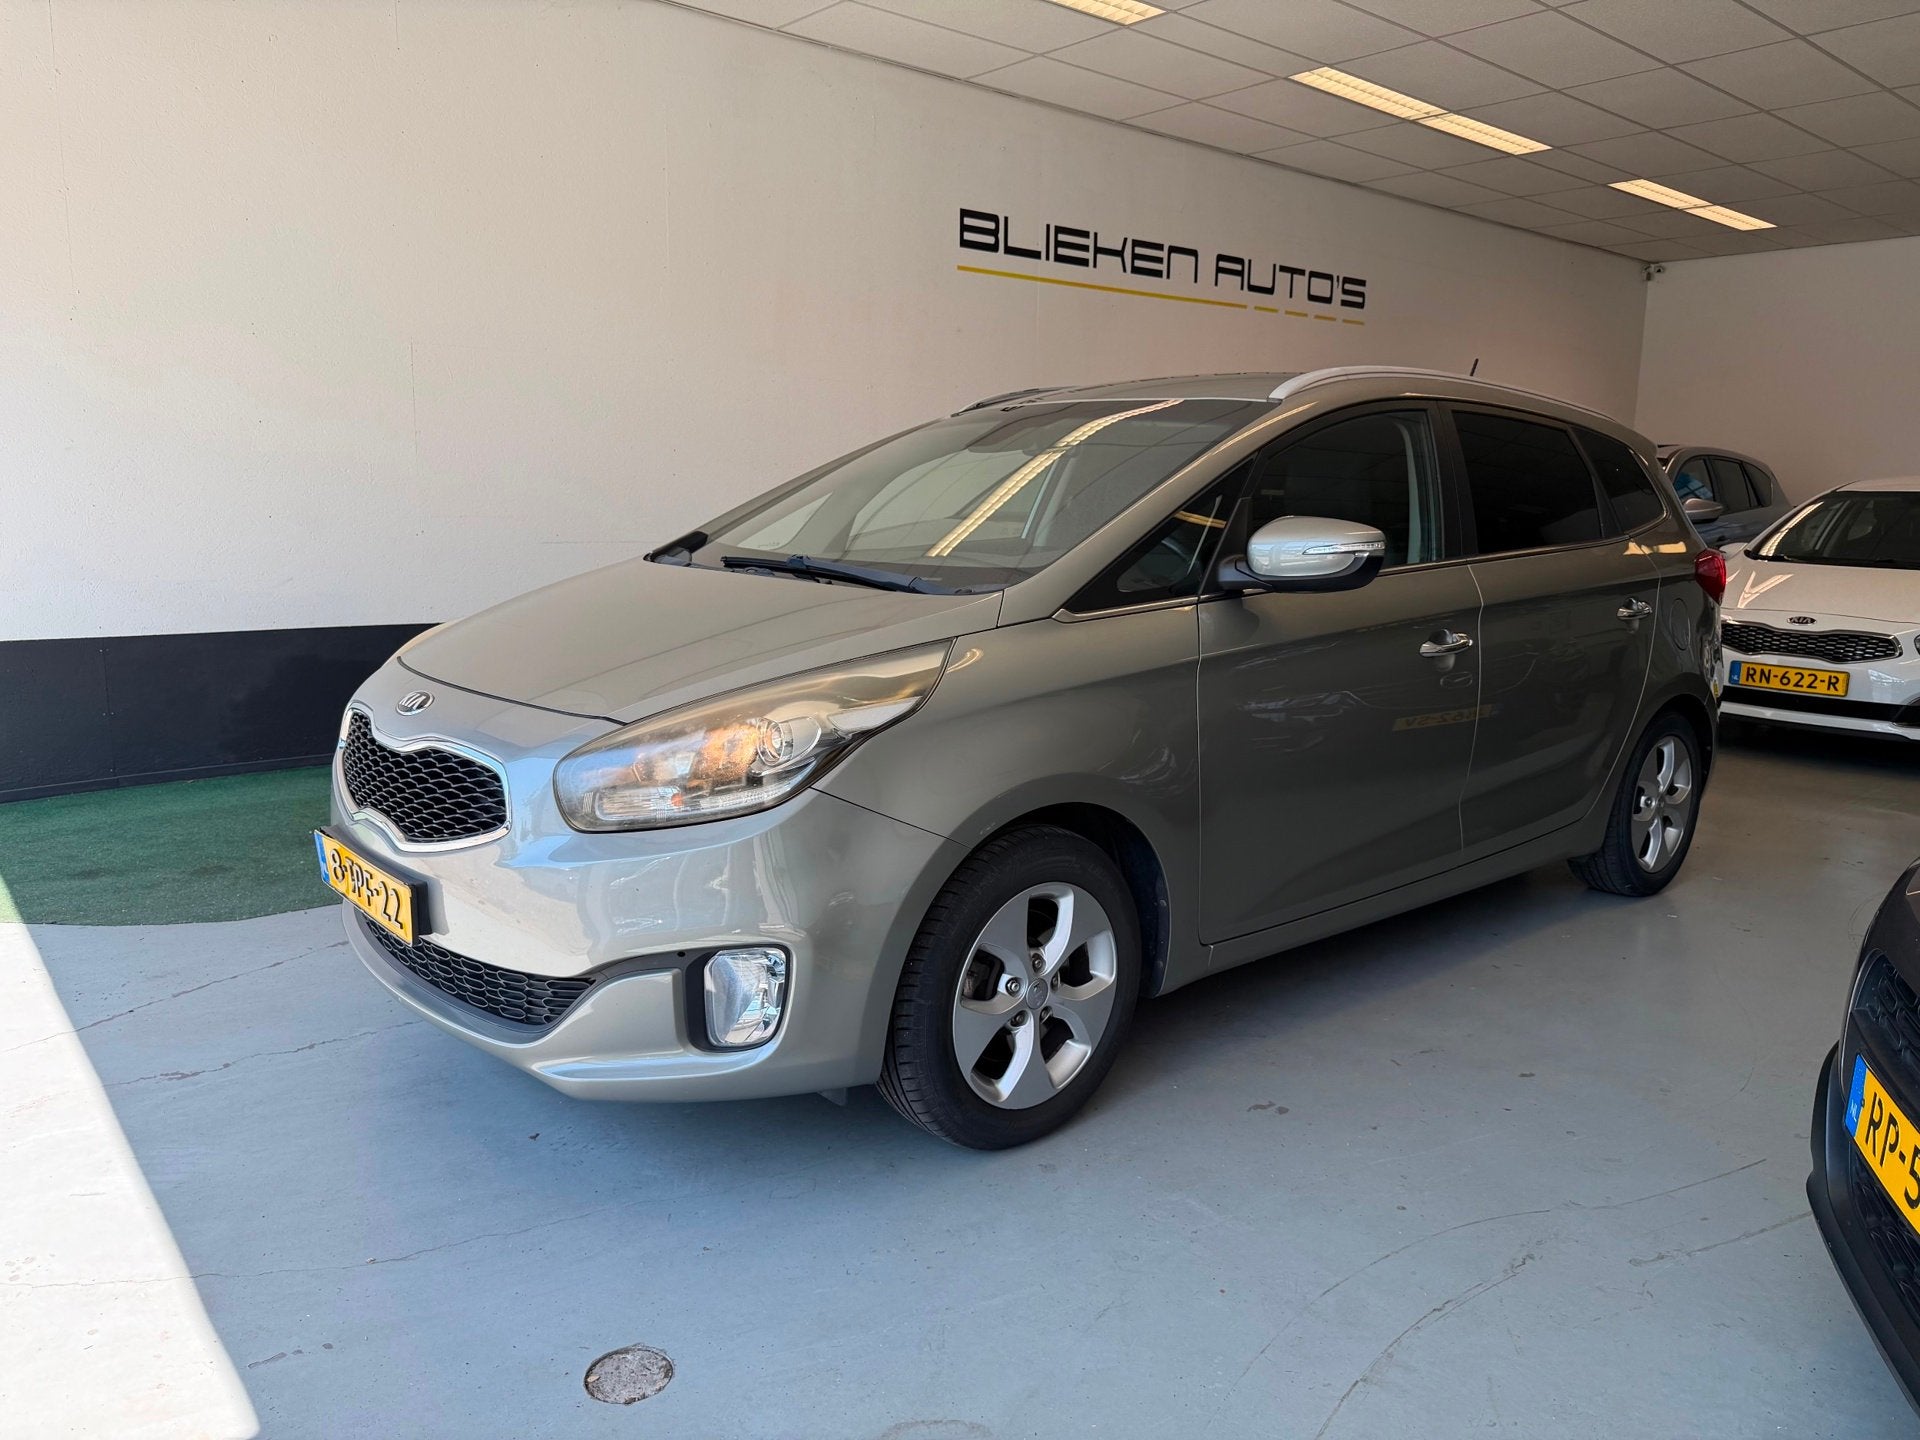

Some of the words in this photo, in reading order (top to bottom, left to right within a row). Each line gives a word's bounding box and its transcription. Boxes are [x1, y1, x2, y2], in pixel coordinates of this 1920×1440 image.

[960, 207, 1198, 283] BLIEKEN
[1215, 253, 1366, 309] AUTO'S
[1745, 666, 1840, 692] RN-622-R
[1865, 1091, 1920, 1210] RP-5
